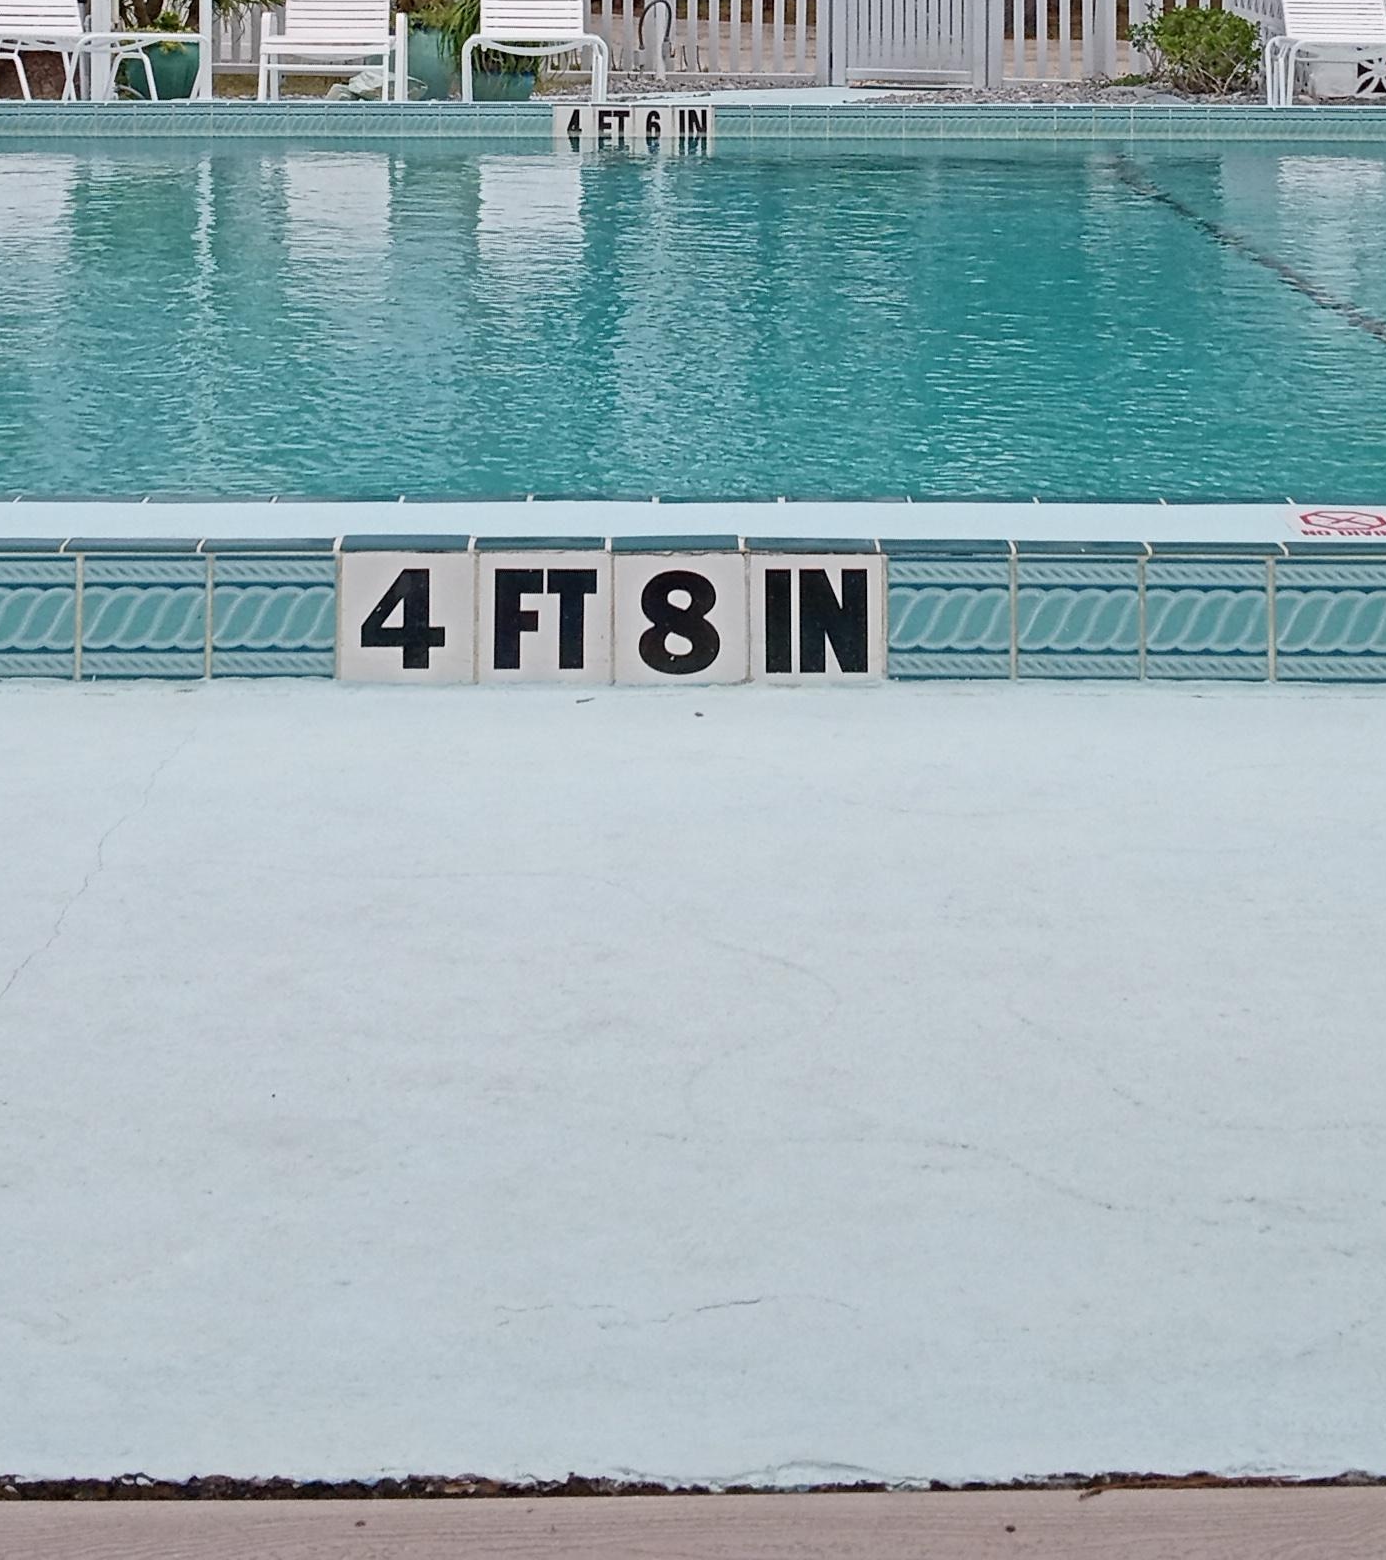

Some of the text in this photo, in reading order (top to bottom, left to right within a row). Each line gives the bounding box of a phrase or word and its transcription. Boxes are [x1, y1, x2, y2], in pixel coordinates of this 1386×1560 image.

[567, 109, 582, 135] 4
[646, 110, 661, 138] 6
[679, 109, 707, 137] IN
[361, 569, 868, 675] 4 FT 8 IN
